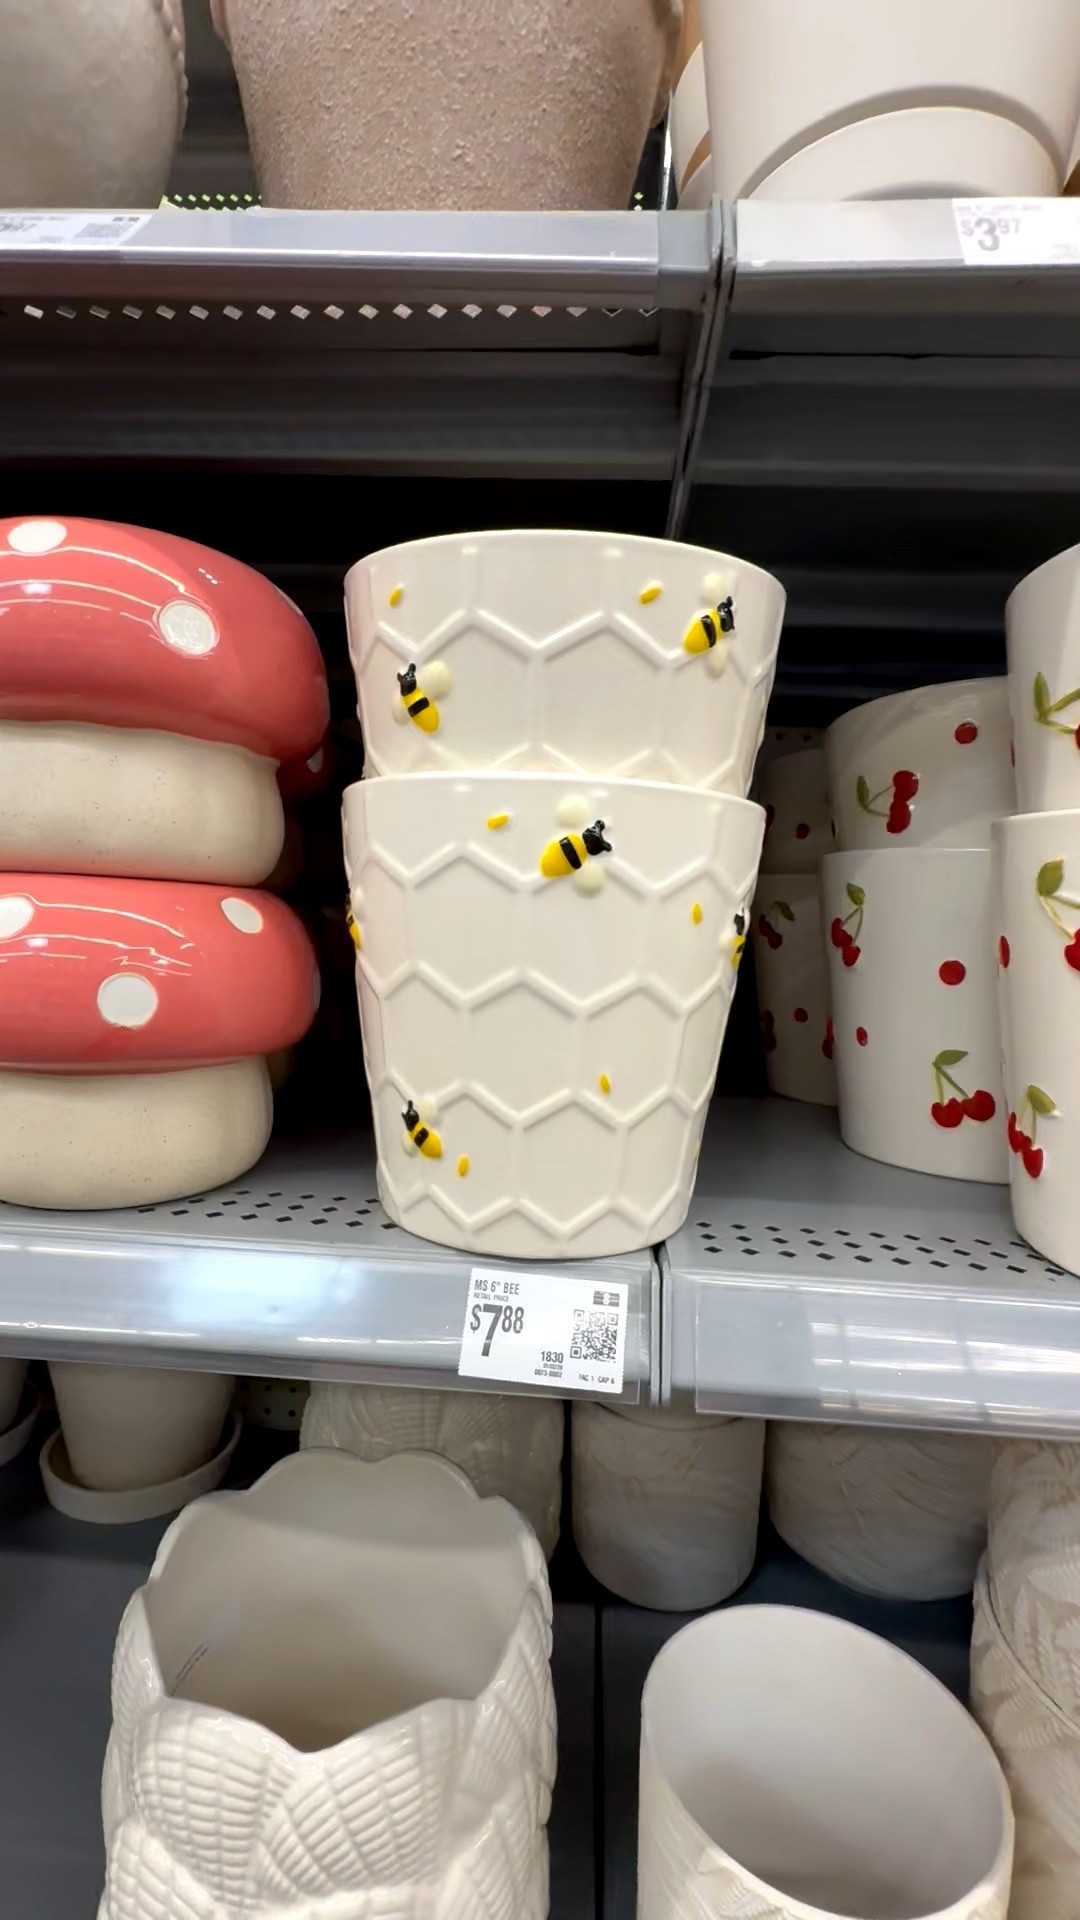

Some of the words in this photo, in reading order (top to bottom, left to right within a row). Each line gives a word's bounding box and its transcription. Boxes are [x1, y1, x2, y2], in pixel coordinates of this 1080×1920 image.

[474, 1280, 489, 1291] MS
[503, 1282, 520, 1295] BEE
[541, 1350, 564, 1363] 1830
